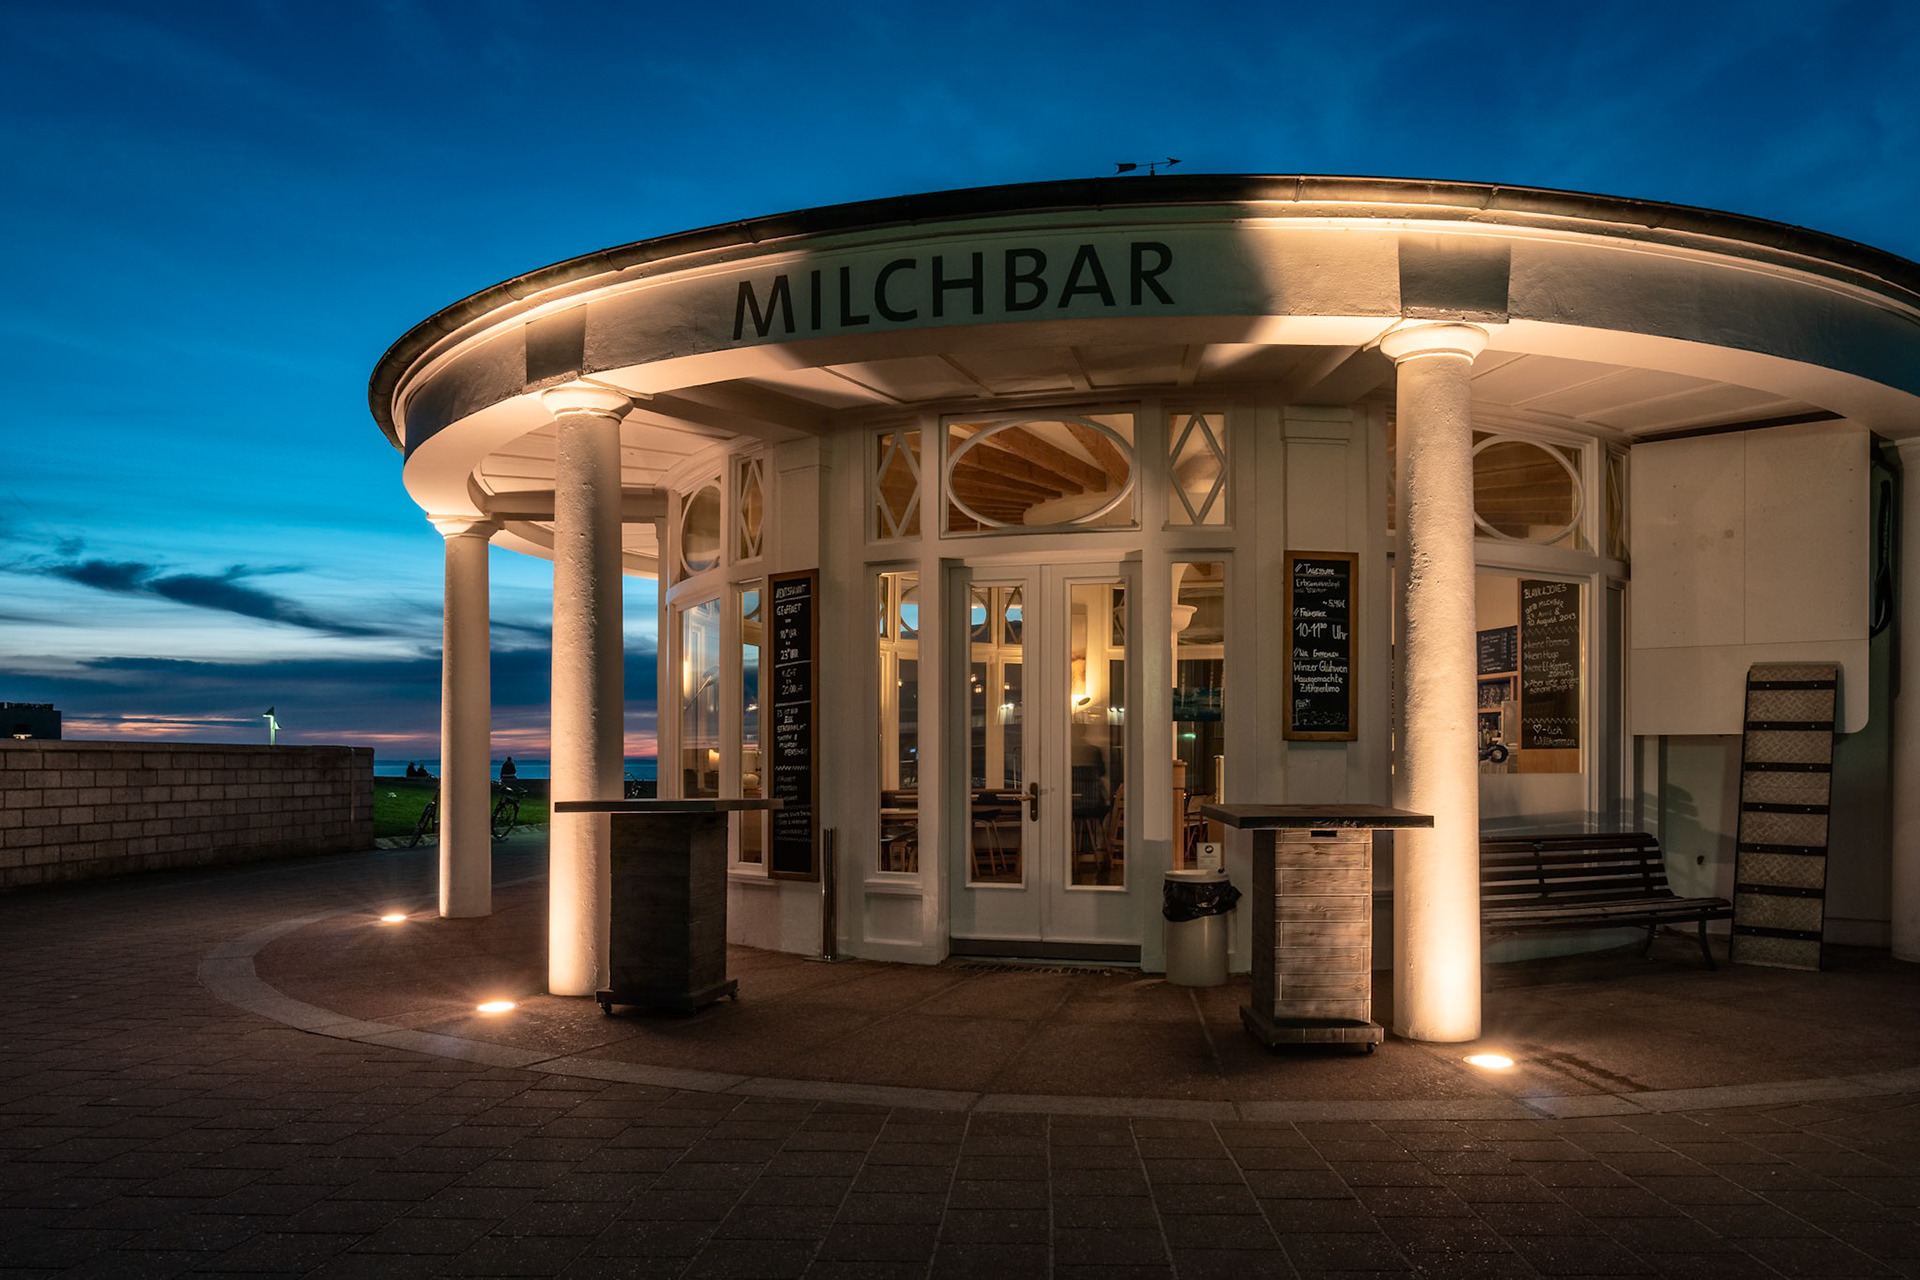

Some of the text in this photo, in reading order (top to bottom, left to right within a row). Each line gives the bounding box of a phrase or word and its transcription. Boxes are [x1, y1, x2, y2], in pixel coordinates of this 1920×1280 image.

[732, 241, 1176, 341] MILCHBAR
[1536, 616, 1557, 627] August
[1332, 624, 1349, 640] Uhr
[1543, 650, 1559, 662] Hugo
[1293, 661, 1318, 672] Winzer
[1293, 673, 1343, 685] Hausgemachte
